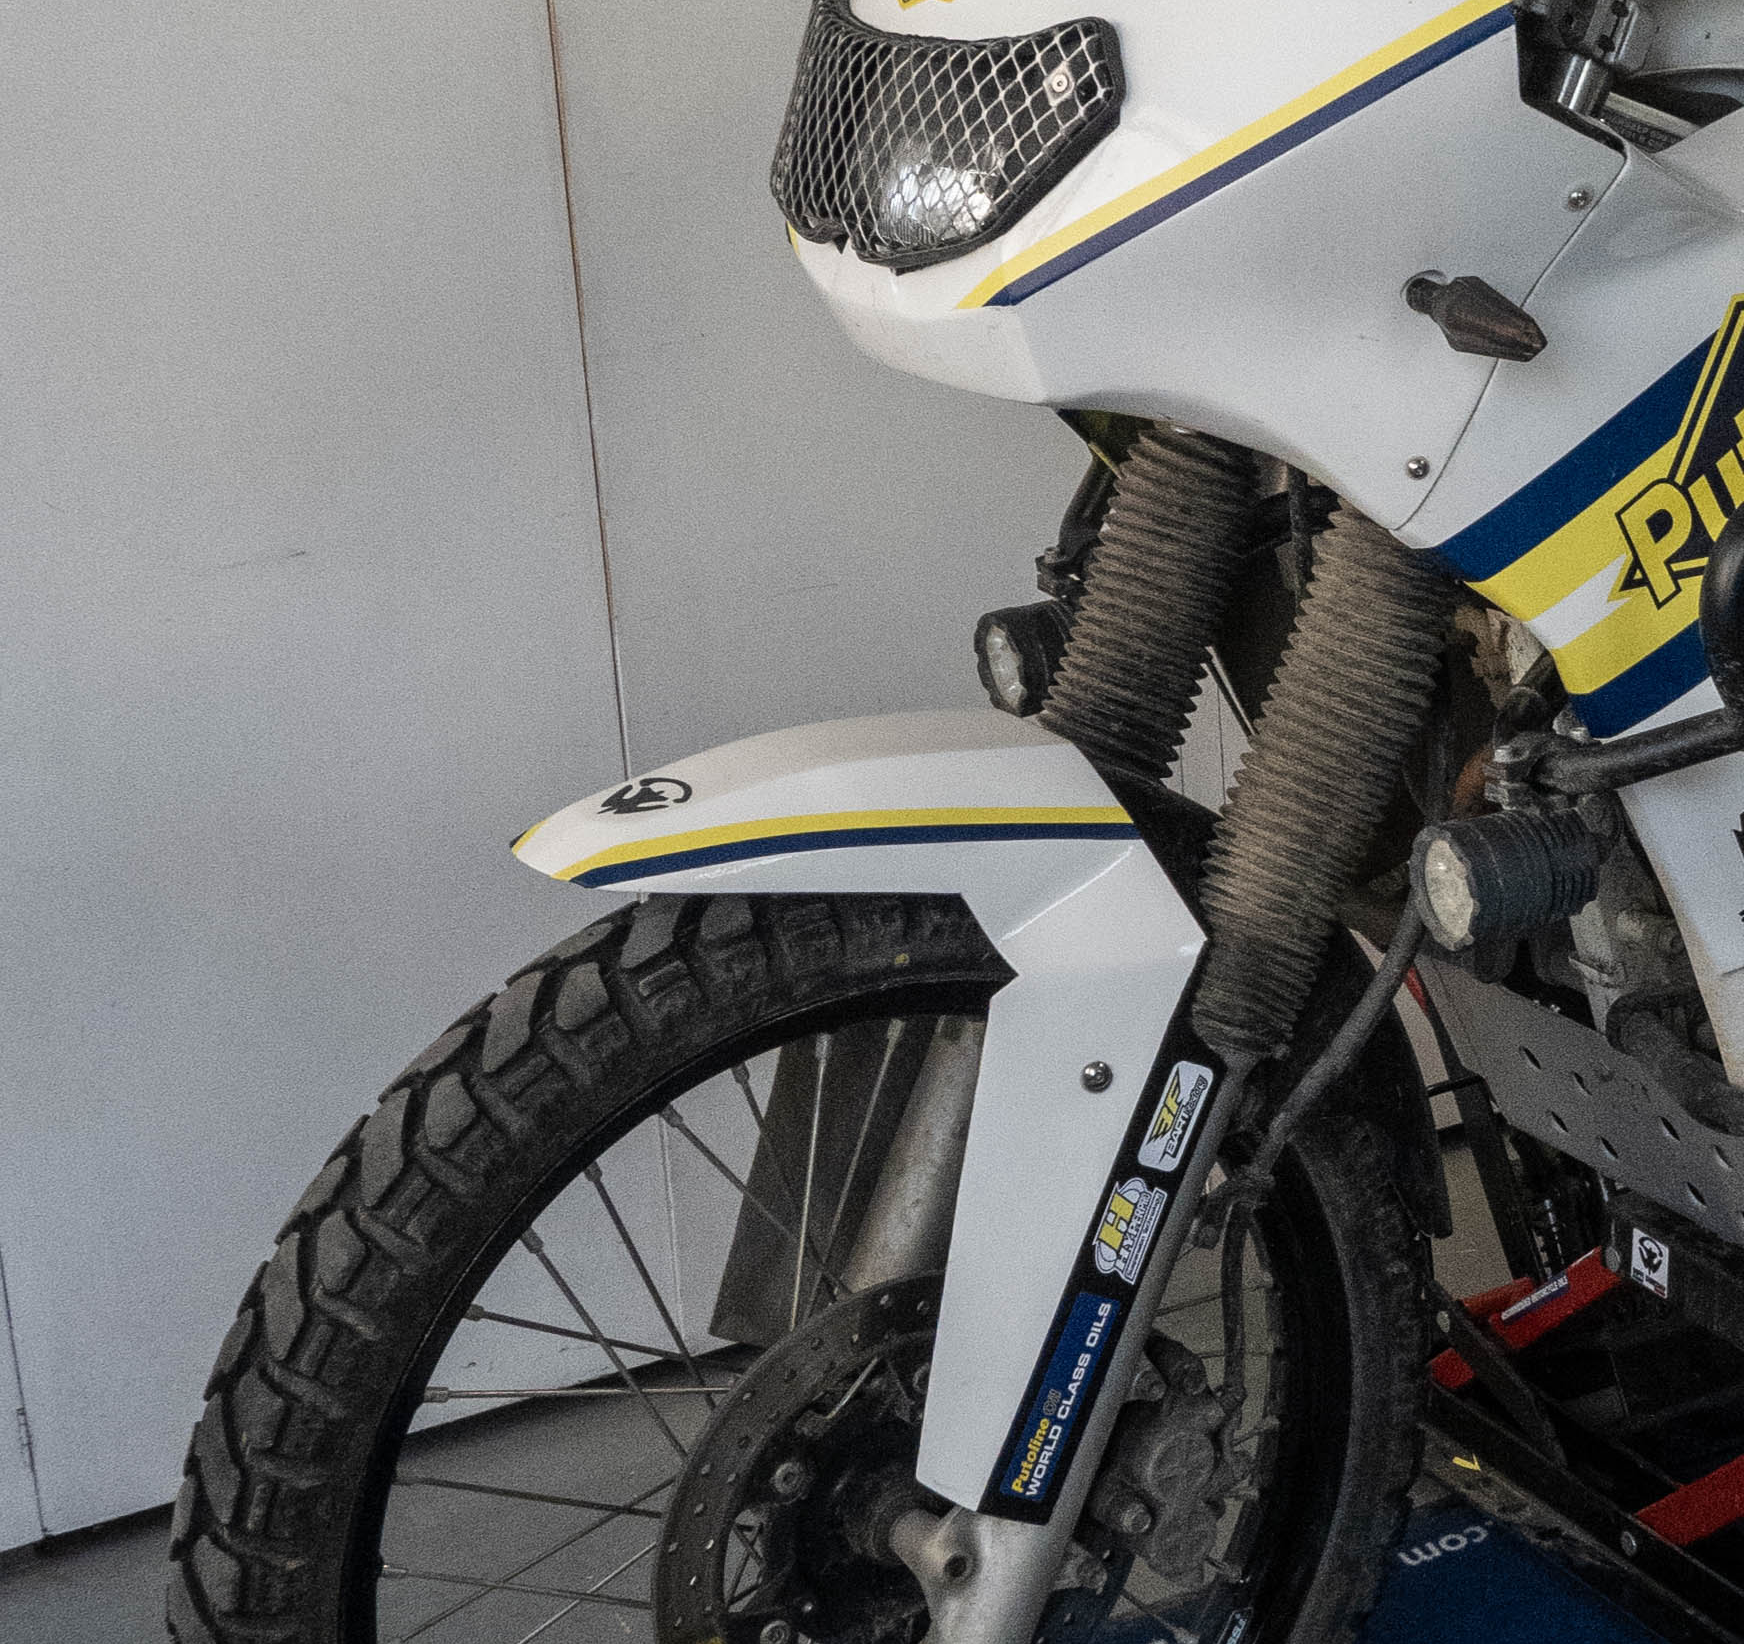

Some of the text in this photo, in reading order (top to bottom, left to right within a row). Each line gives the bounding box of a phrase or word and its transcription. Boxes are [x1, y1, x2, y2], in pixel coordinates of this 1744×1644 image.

[1115, 1191, 1152, 1273] HYPERPRO
[1024, 1301, 1113, 1497] WORLD CLASS OILS
[1011, 1417, 1050, 1494] Putoline
